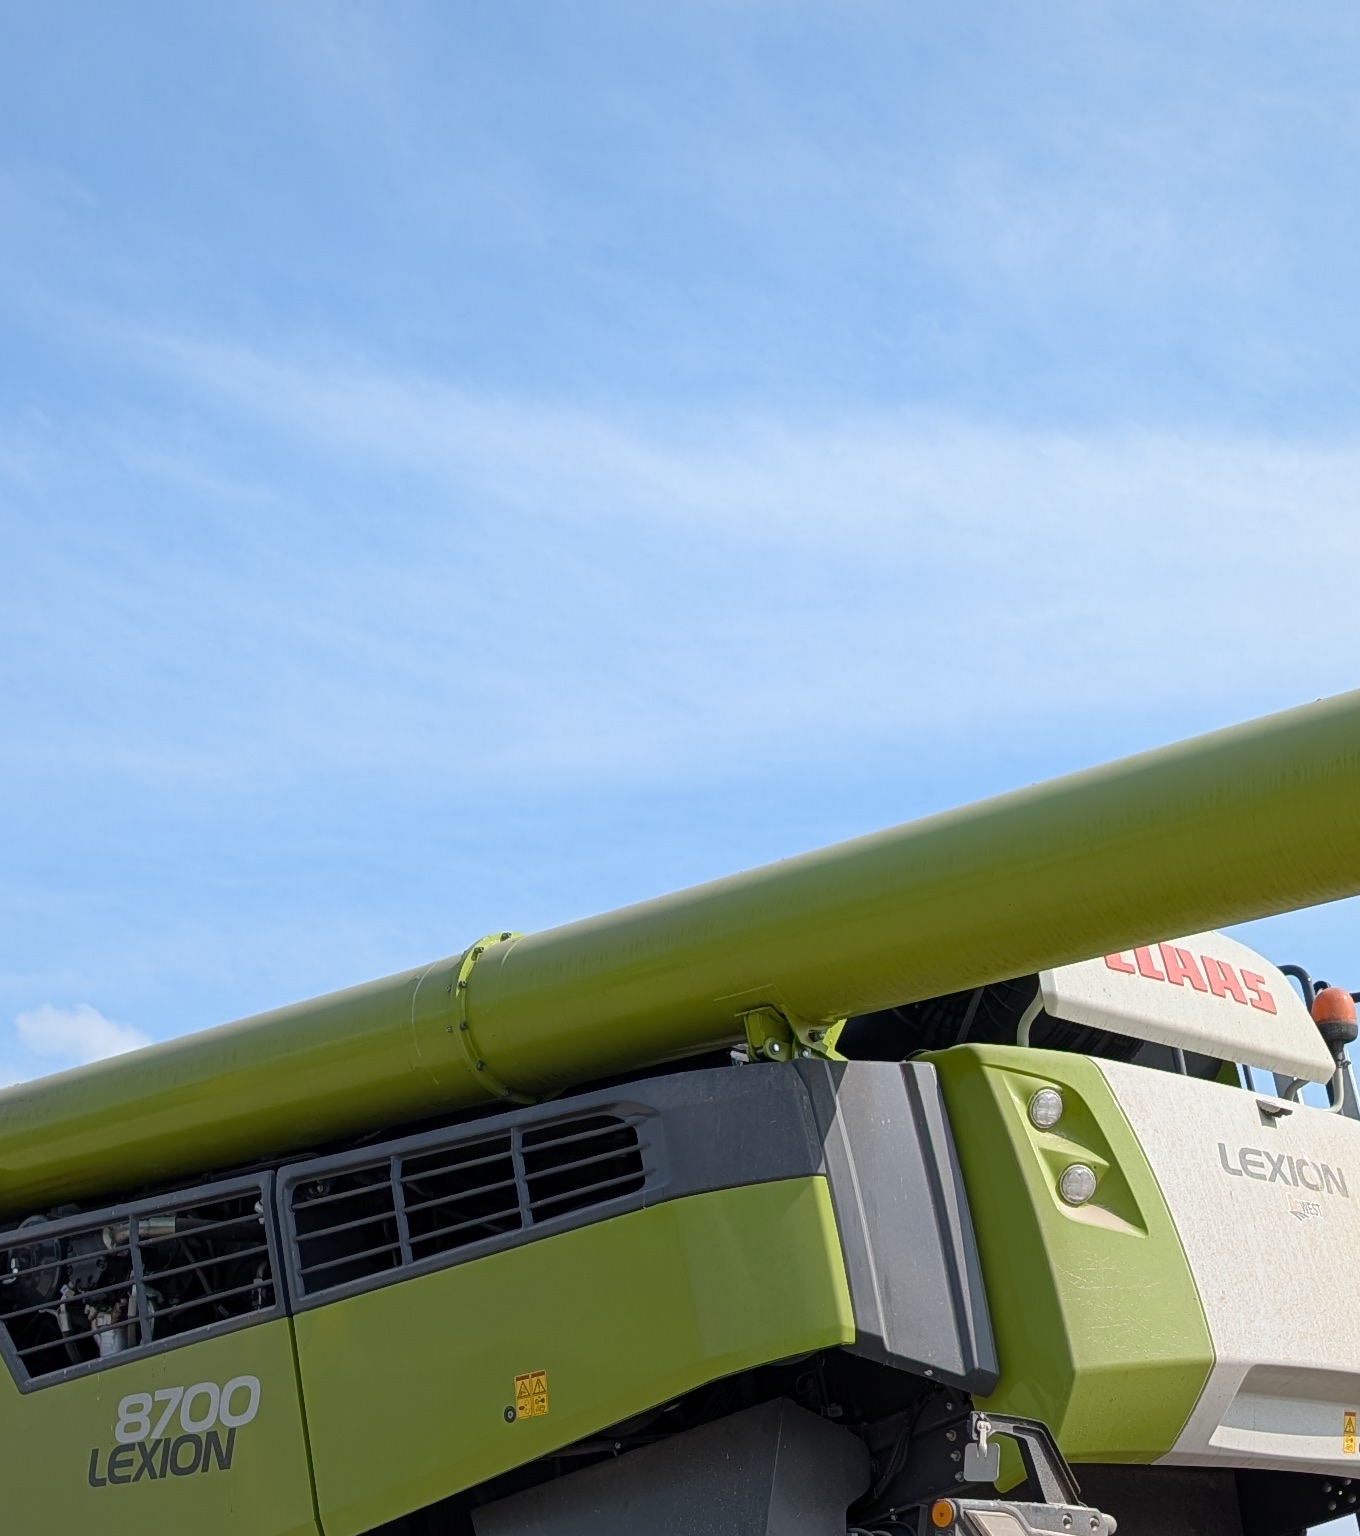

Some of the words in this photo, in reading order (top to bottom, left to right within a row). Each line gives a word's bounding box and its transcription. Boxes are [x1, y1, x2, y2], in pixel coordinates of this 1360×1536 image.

[1217, 1142, 1350, 1199] LEXION
[114, 1375, 262, 1445] 8700
[88, 1427, 236, 1489] LEXION
